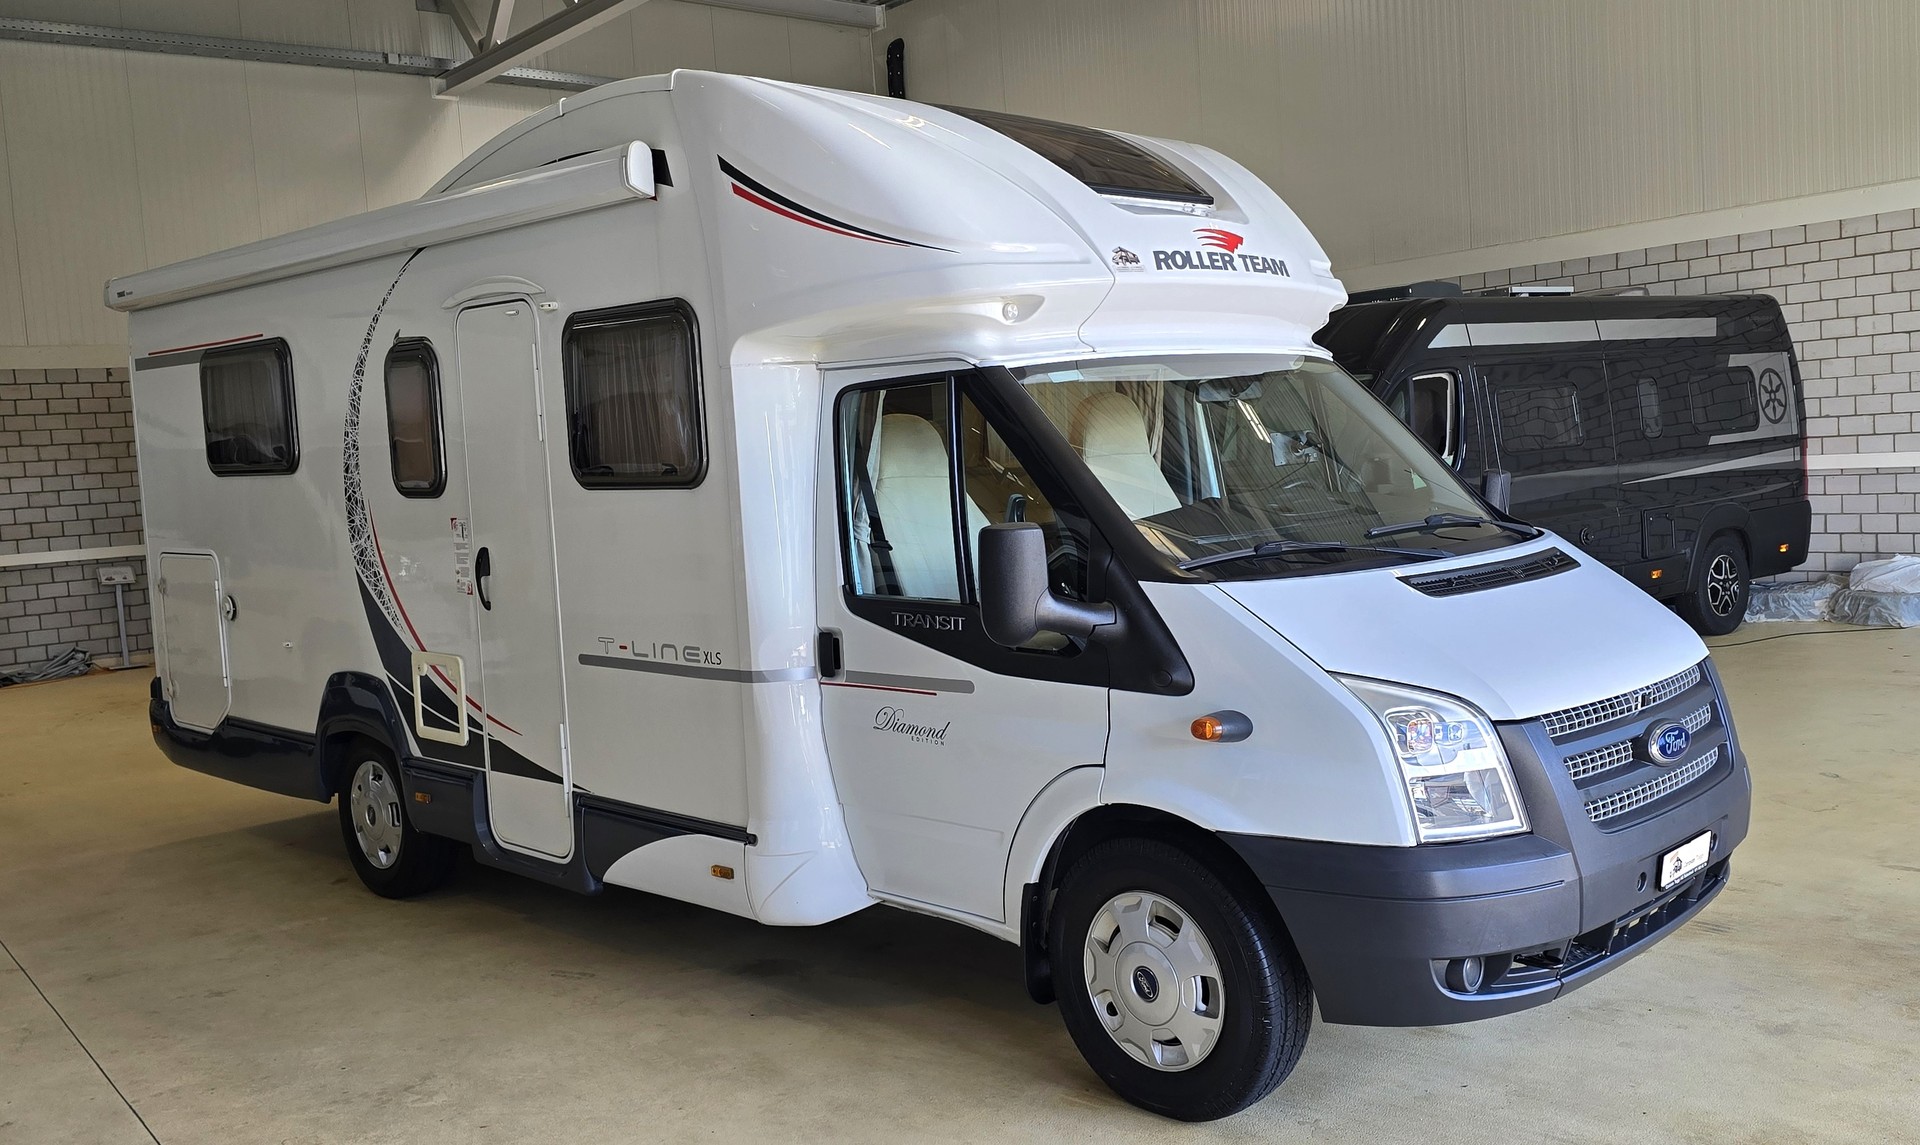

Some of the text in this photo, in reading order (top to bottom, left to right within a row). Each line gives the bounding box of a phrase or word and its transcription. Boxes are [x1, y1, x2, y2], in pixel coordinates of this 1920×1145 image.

[1152, 250, 1290, 277] ROLLER TEAM
[891, 611, 966, 631] TRANSIT
[703, 651, 722, 665] XLS
[873, 706, 951, 740] Diamond
[911, 736, 945, 746] EDITION
[1665, 730, 1686, 754] Ford
